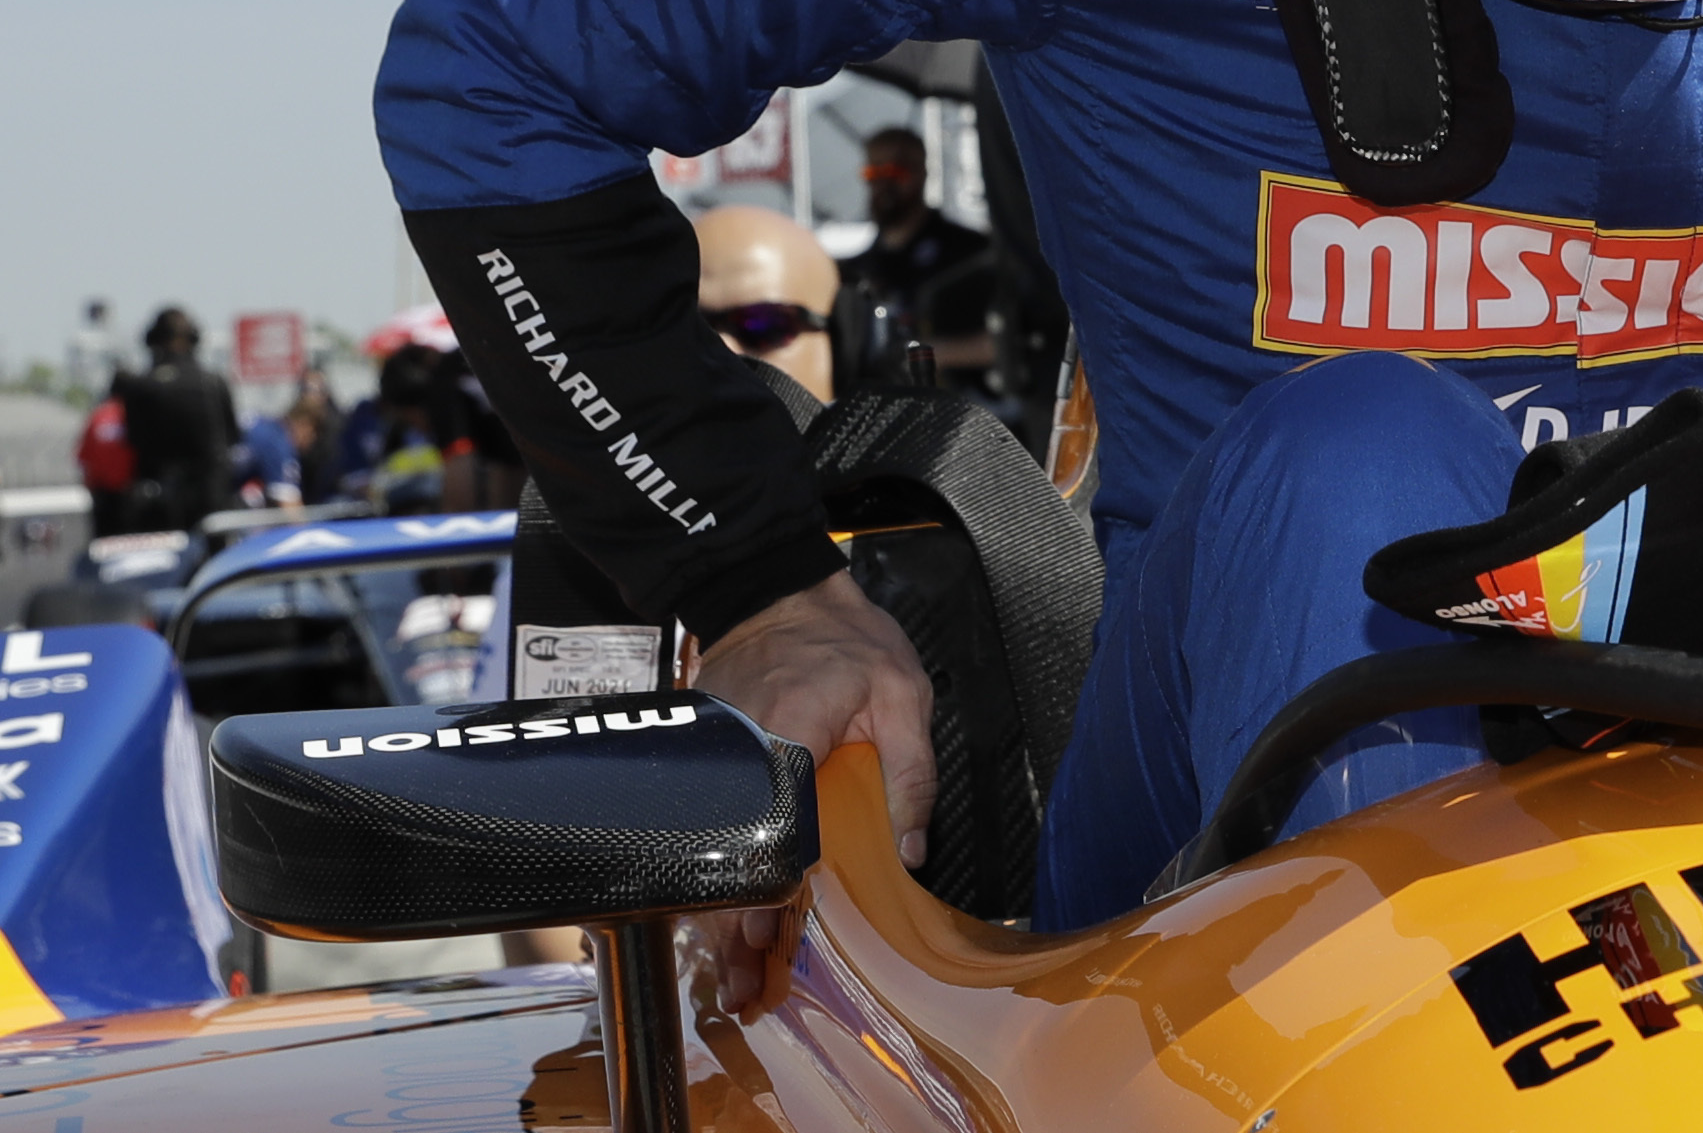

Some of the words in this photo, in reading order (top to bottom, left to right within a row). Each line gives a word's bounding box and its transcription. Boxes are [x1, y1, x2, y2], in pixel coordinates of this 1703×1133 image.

[476, 247, 622, 432] RICHARD
[1435, 590, 1528, 620] ALONSO
[541, 678, 579, 695] JUN
